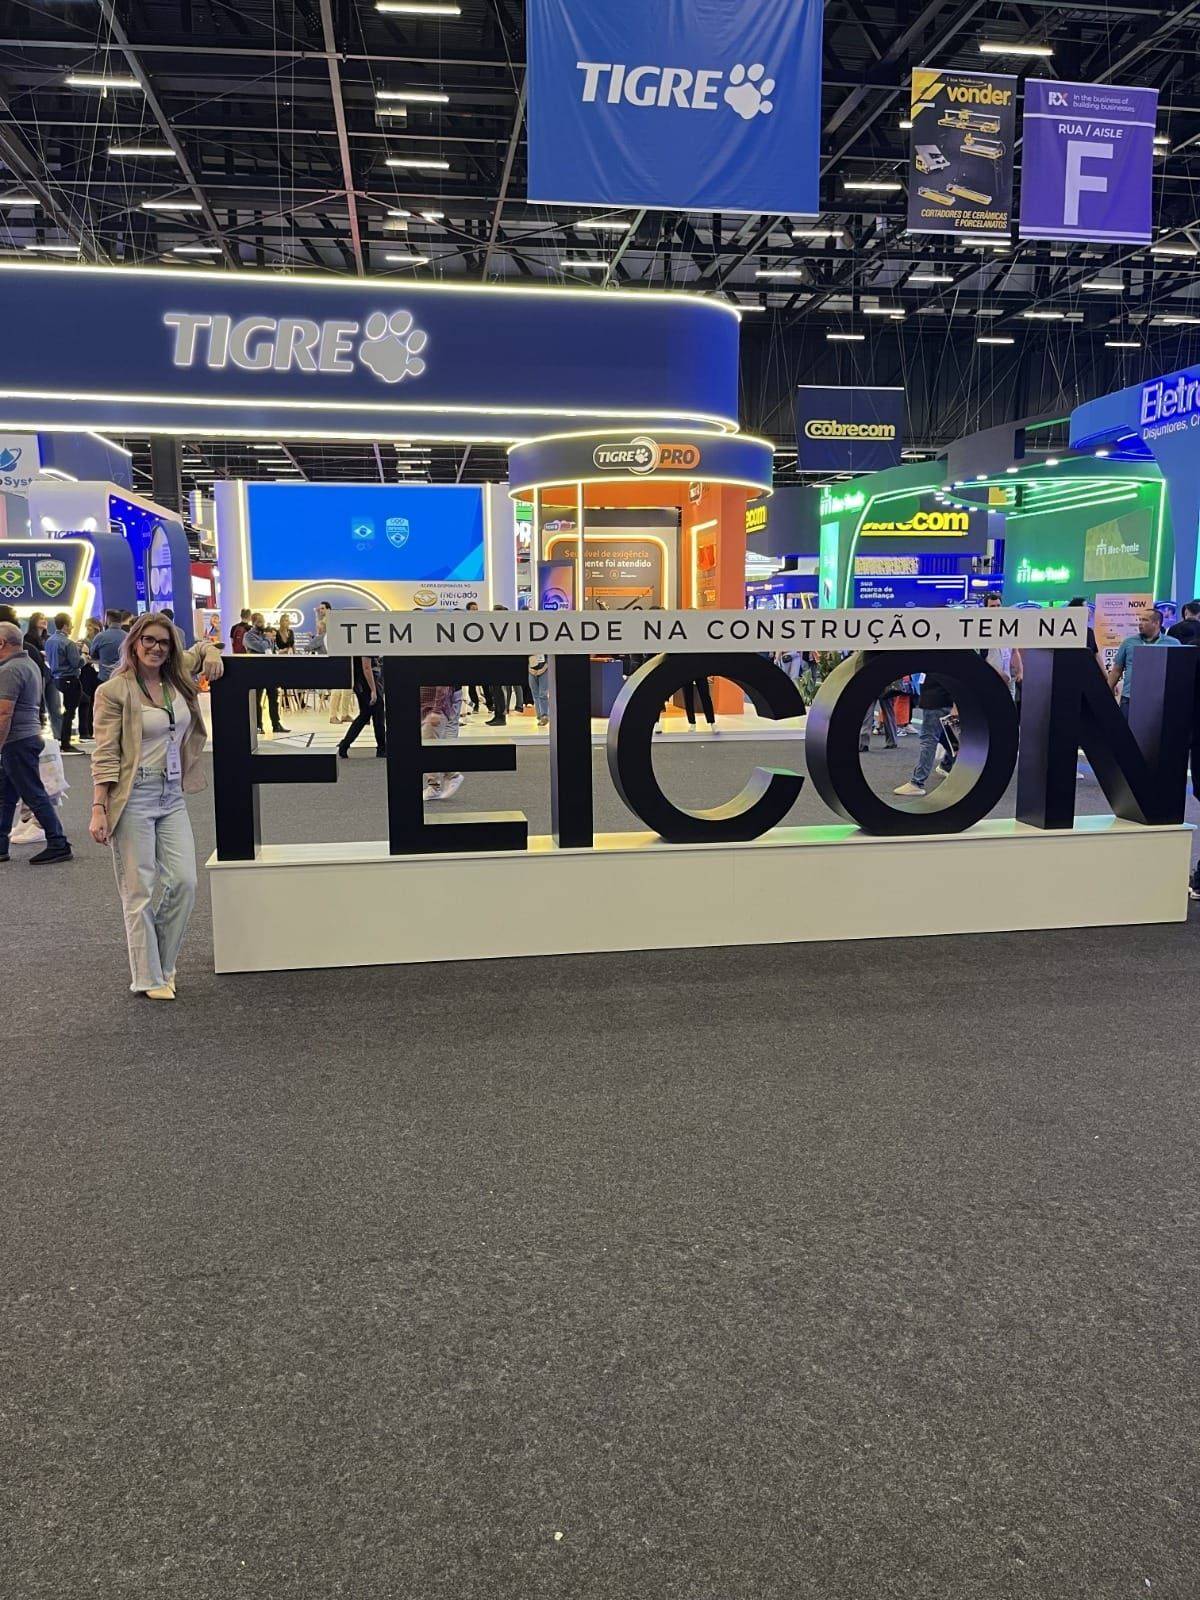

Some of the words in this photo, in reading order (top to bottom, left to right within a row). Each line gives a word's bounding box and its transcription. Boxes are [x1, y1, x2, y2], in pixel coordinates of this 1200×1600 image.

[576, 61, 723, 110] TIGRE
[946, 83, 1012, 106] vonder
[1093, 96, 1120, 104] business
[1072, 101, 1100, 111] building
[1100, 103, 1135, 113] businesses
[1058, 123, 1084, 136] RUA
[1092, 127, 1123, 138] AISLE
[1063, 140, 1114, 226] F
[921, 208, 961, 219] CORTADORES
[962, 210, 971, 219] DE
[954, 218, 960, 227] E
[960, 219, 1008, 229] PORCELANATOS
[164, 312, 359, 372] TIGRE
[810, 420, 896, 437] cobrecom
[1143, 419, 1189, 440] Disjuntores,
[598, 451, 635, 463] TIGRE
[659, 448, 695, 464] PRO
[601, 549, 611, 558] de
[612, 548, 649, 560] exigência
[605, 559, 616, 568] foi
[617, 559, 652, 568] atendido
[440, 591, 478, 599] mercado
[340, 622, 413, 643] TEM
[436, 621, 622, 643] NOVIDADE
[643, 620, 687, 641] NA
[707, 614, 941, 644] CONSTRUÇÃO,
[960, 617, 1019, 638] TEM
[1038, 617, 1078, 637] NA
[210, 647, 1197, 860] FEICON
